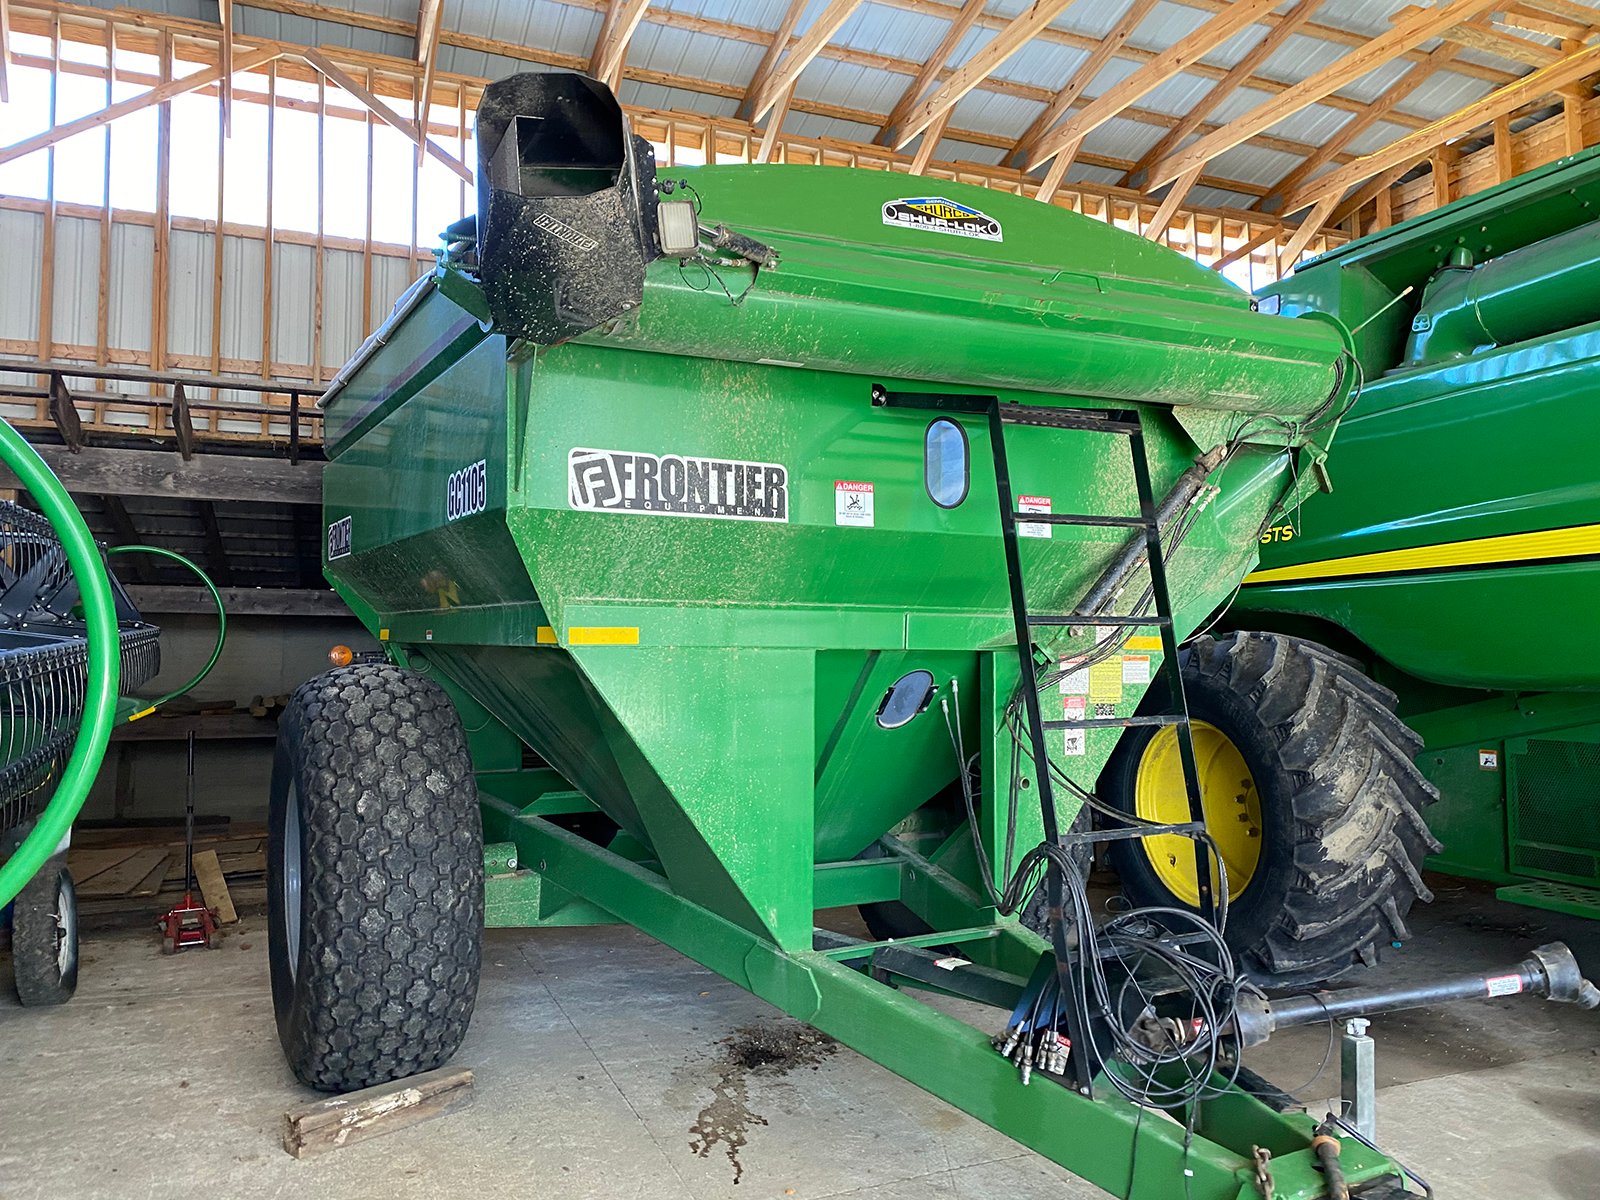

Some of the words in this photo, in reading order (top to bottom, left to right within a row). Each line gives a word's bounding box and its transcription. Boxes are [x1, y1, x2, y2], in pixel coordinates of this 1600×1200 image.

[897, 212, 988, 234] SHUR-LOK
[448, 463, 486, 518] GC1105
[610, 452, 788, 513] FRONTIER
[842, 483, 873, 491] DANGER
[624, 499, 778, 517] EQUIPMENT
[1025, 497, 1051, 505] DANGER
[1260, 525, 1294, 544] STS
